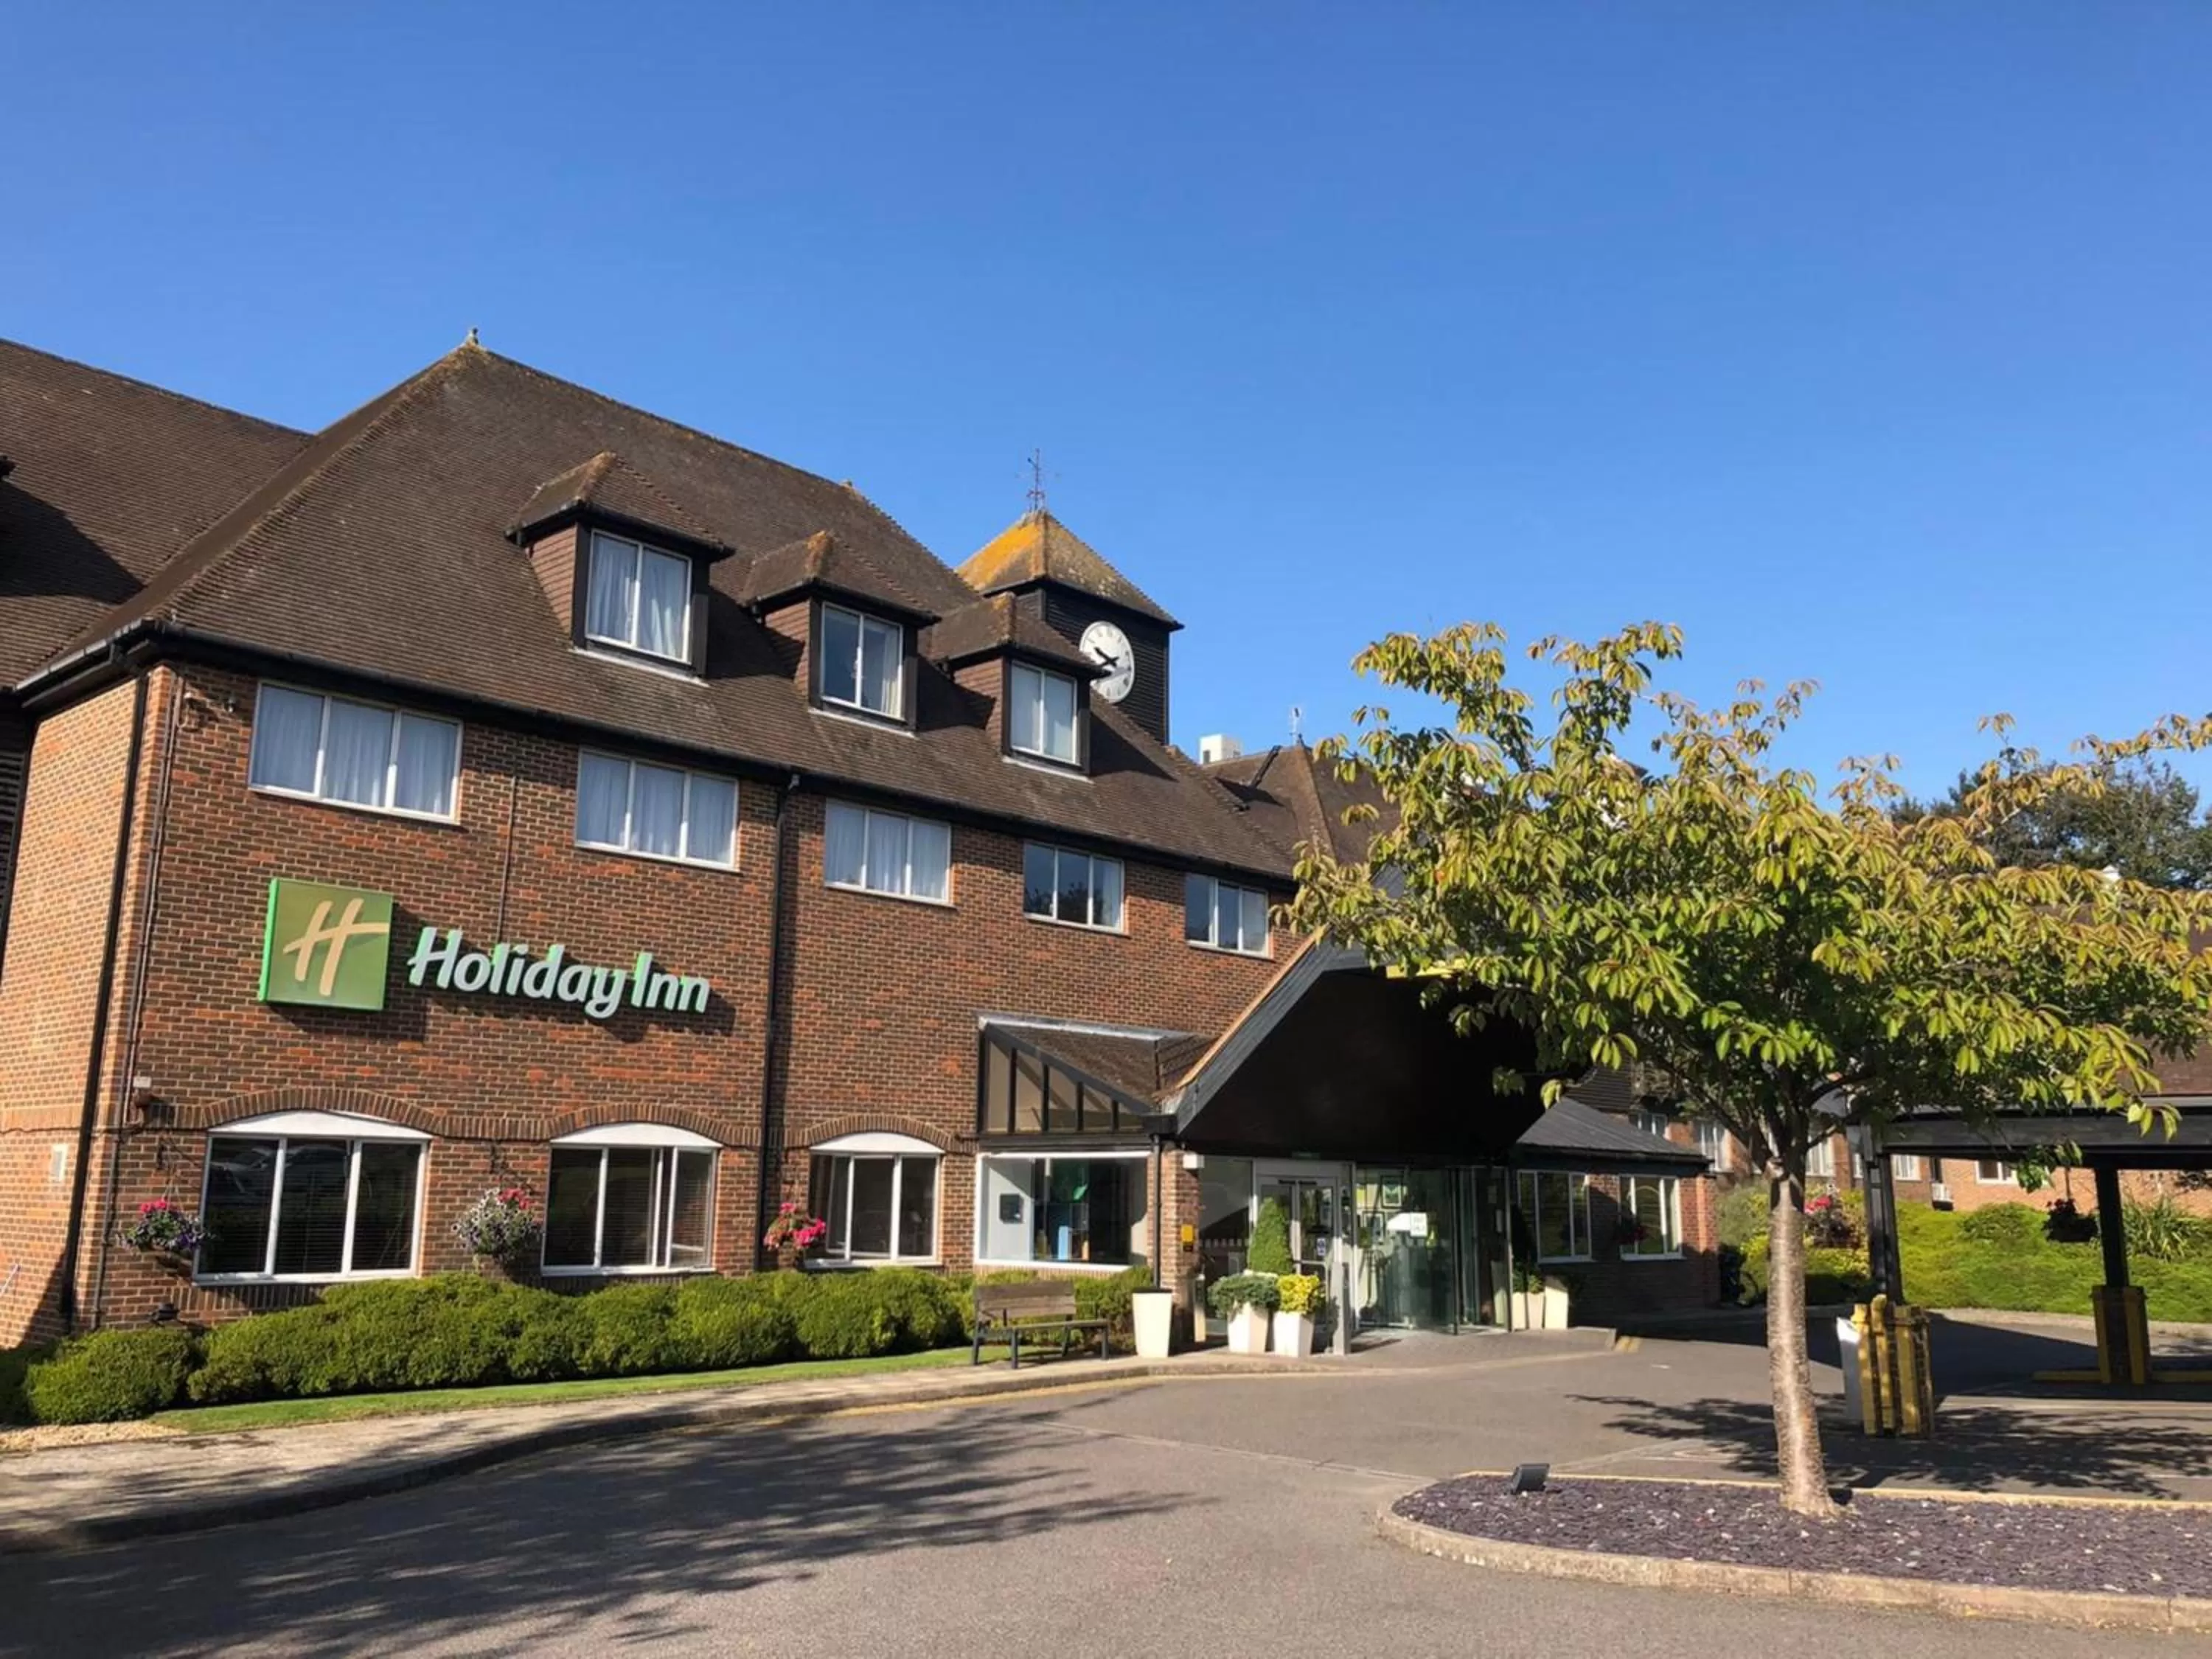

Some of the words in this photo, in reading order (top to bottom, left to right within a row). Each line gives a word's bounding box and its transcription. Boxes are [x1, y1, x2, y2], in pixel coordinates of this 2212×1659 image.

[283, 898, 390, 996] H
[407, 926, 627, 1019] Holiday
[630, 952, 710, 1014] Inn
